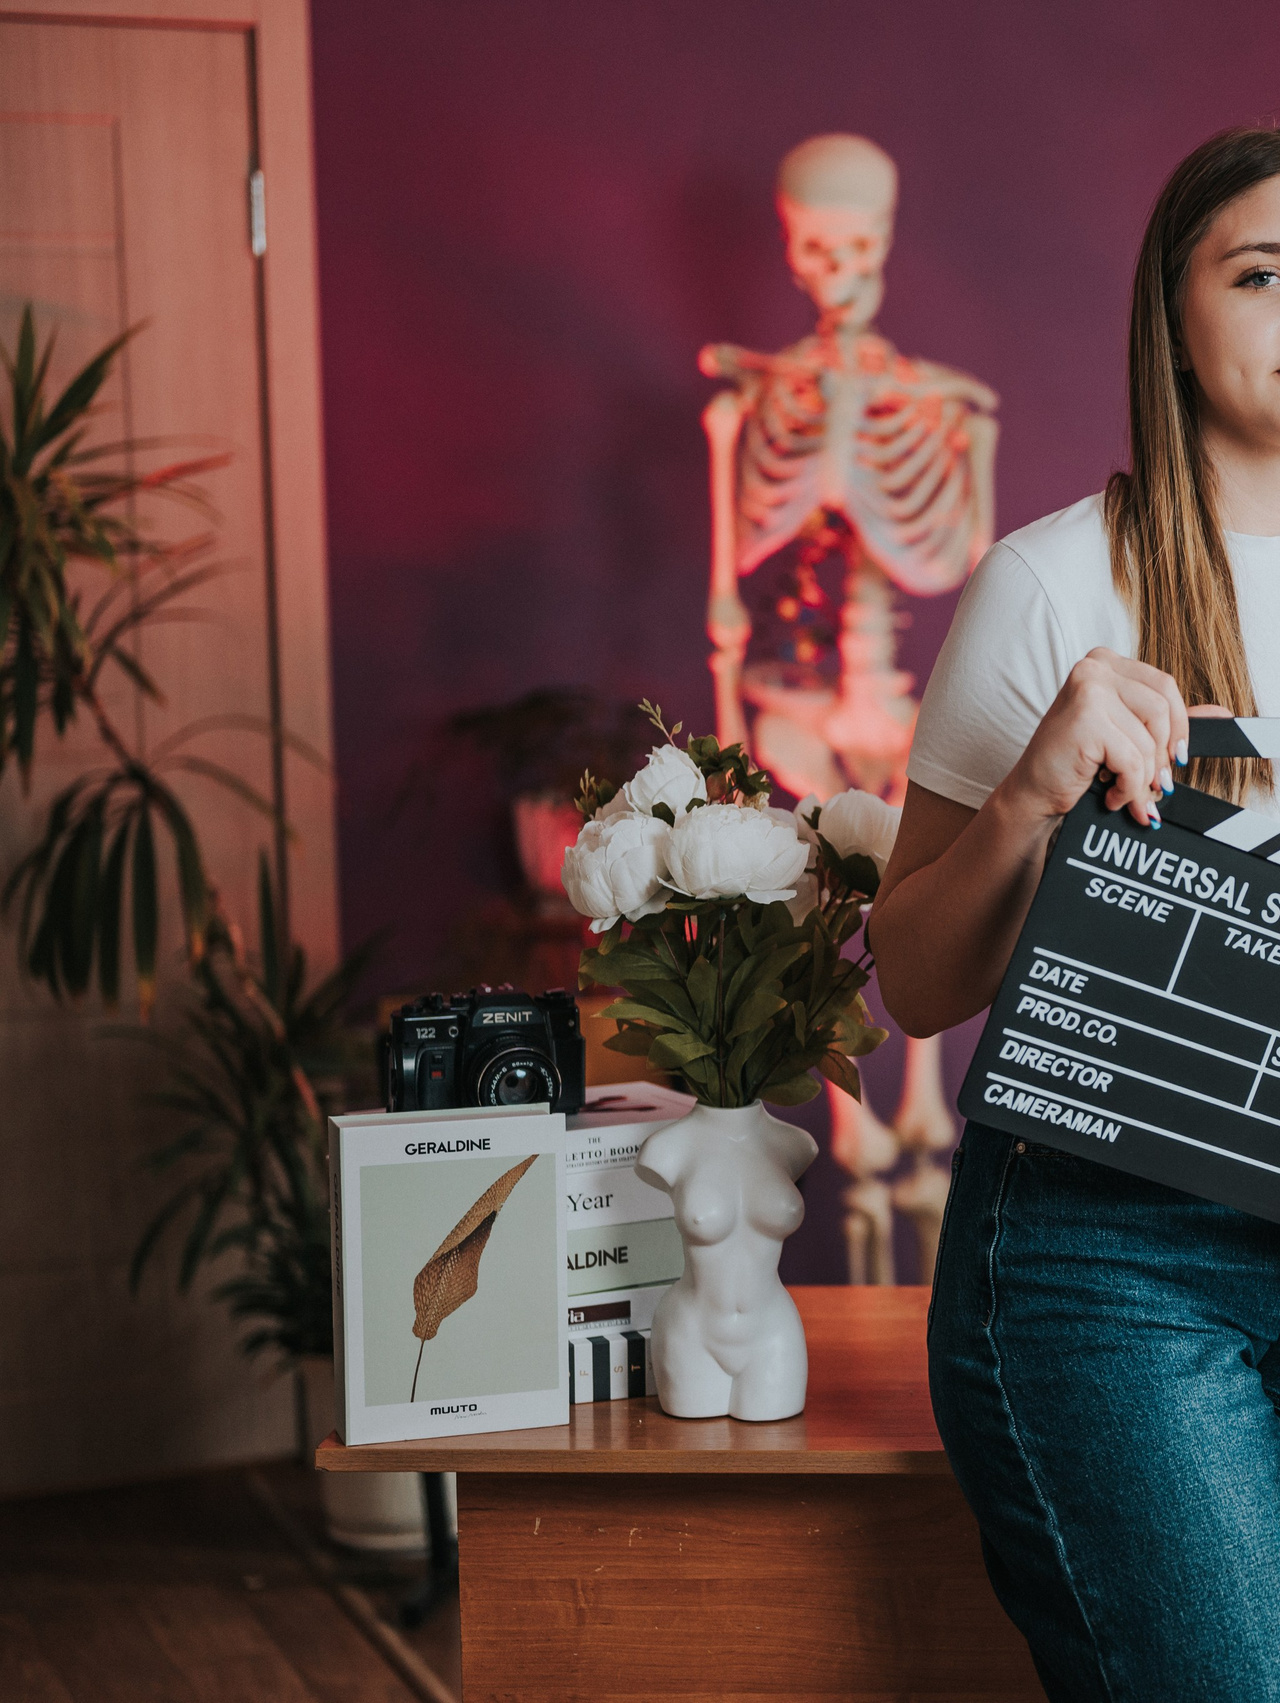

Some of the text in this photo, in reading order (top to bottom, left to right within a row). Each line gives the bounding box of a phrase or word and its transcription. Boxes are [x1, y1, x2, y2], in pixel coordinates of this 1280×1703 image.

[1083, 825, 1250, 915] UNIVERSAL
[1085, 878, 1174, 923] SCENE
[1029, 960, 1089, 994] DATE
[483, 1011, 533, 1025] ZENIT
[1017, 996, 1117, 1047] PROD.CO.
[416, 1028, 436, 1040] 122
[999, 1040, 1114, 1092] DIRECTOR
[984, 1084, 1122, 1143] CAMERAMAN
[404, 1138, 491, 1155] GERALDINE
[565, 1149, 602, 1162] LETTO
[567, 1193, 614, 1212] Year
[333, 1173, 341, 1298] GERALDINE
[567, 1245, 629, 1271] ALDINE
[430, 1403, 477, 1416] MUUTO
